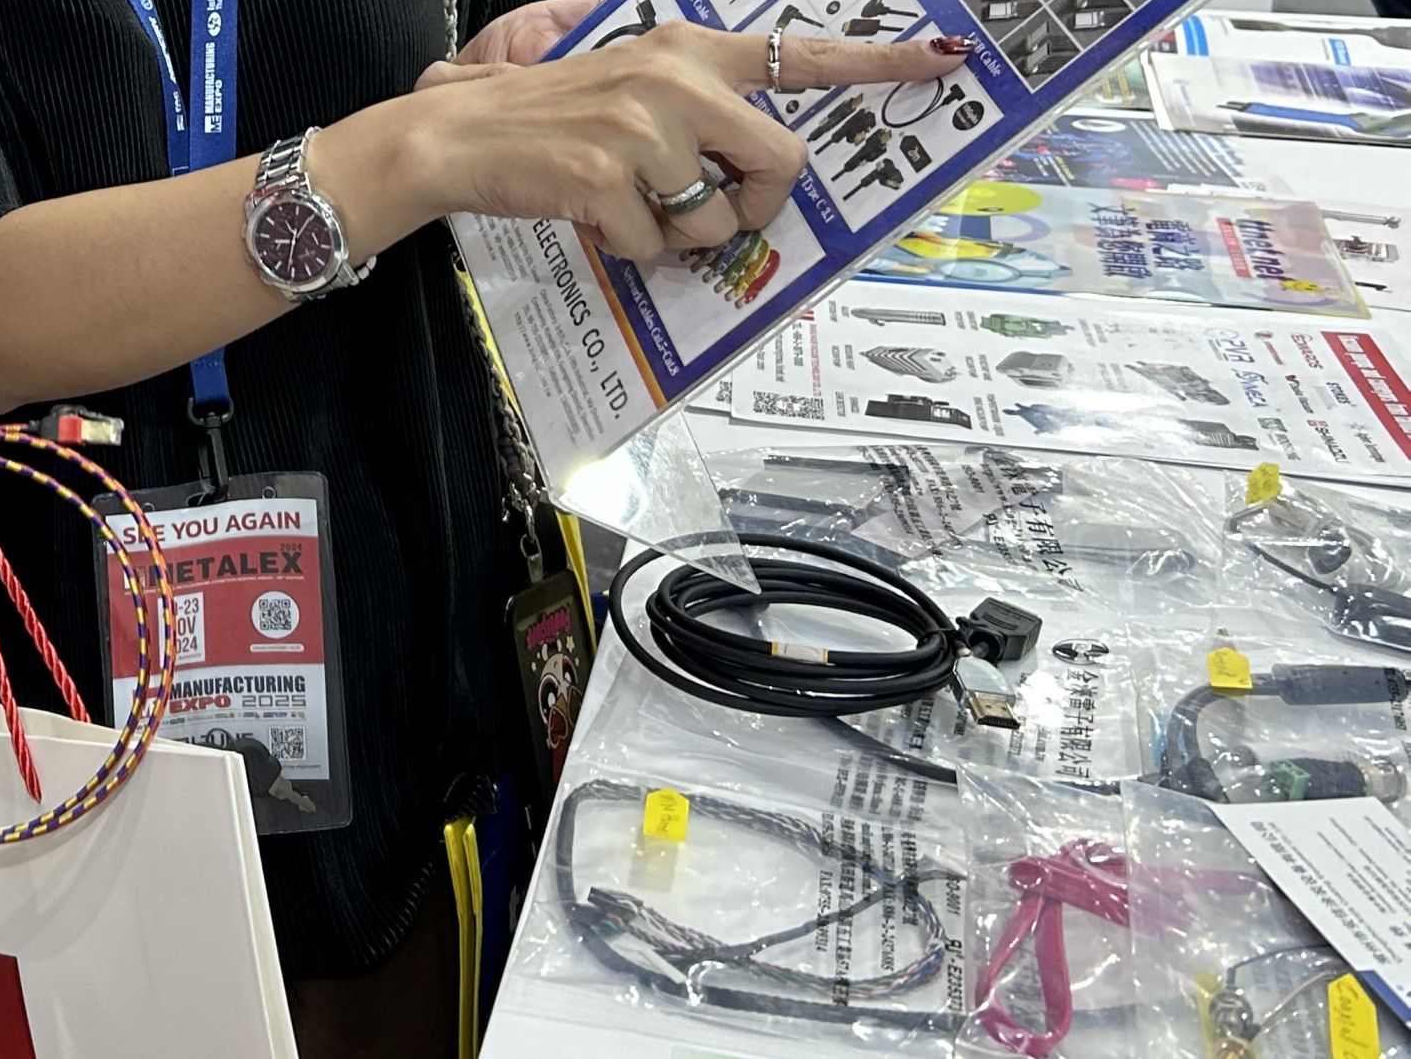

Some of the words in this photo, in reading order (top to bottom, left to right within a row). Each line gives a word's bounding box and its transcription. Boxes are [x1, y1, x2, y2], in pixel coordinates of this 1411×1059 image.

[205, 42, 215, 114] MANUFACTURING
[978, 49, 1004, 78] Cable
[799, 176, 823, 202] Type
[620, 266, 642, 303] Network
[637, 299, 657, 330] Cables
[532, 217, 591, 327] ELECTRONICS
[582, 328, 605, 373] CO.,
[600, 371, 630, 420] LTD.
[171, 517, 218, 540] YOU
[225, 511, 301, 533] AGAIN
[149, 551, 304, 587] METALEX
[169, 675, 306, 700] MANUFACTURING
[169, 694, 232, 714] EXPO
[242, 694, 306, 708] 2025
[945, 875, 961, 915] SO-9001
